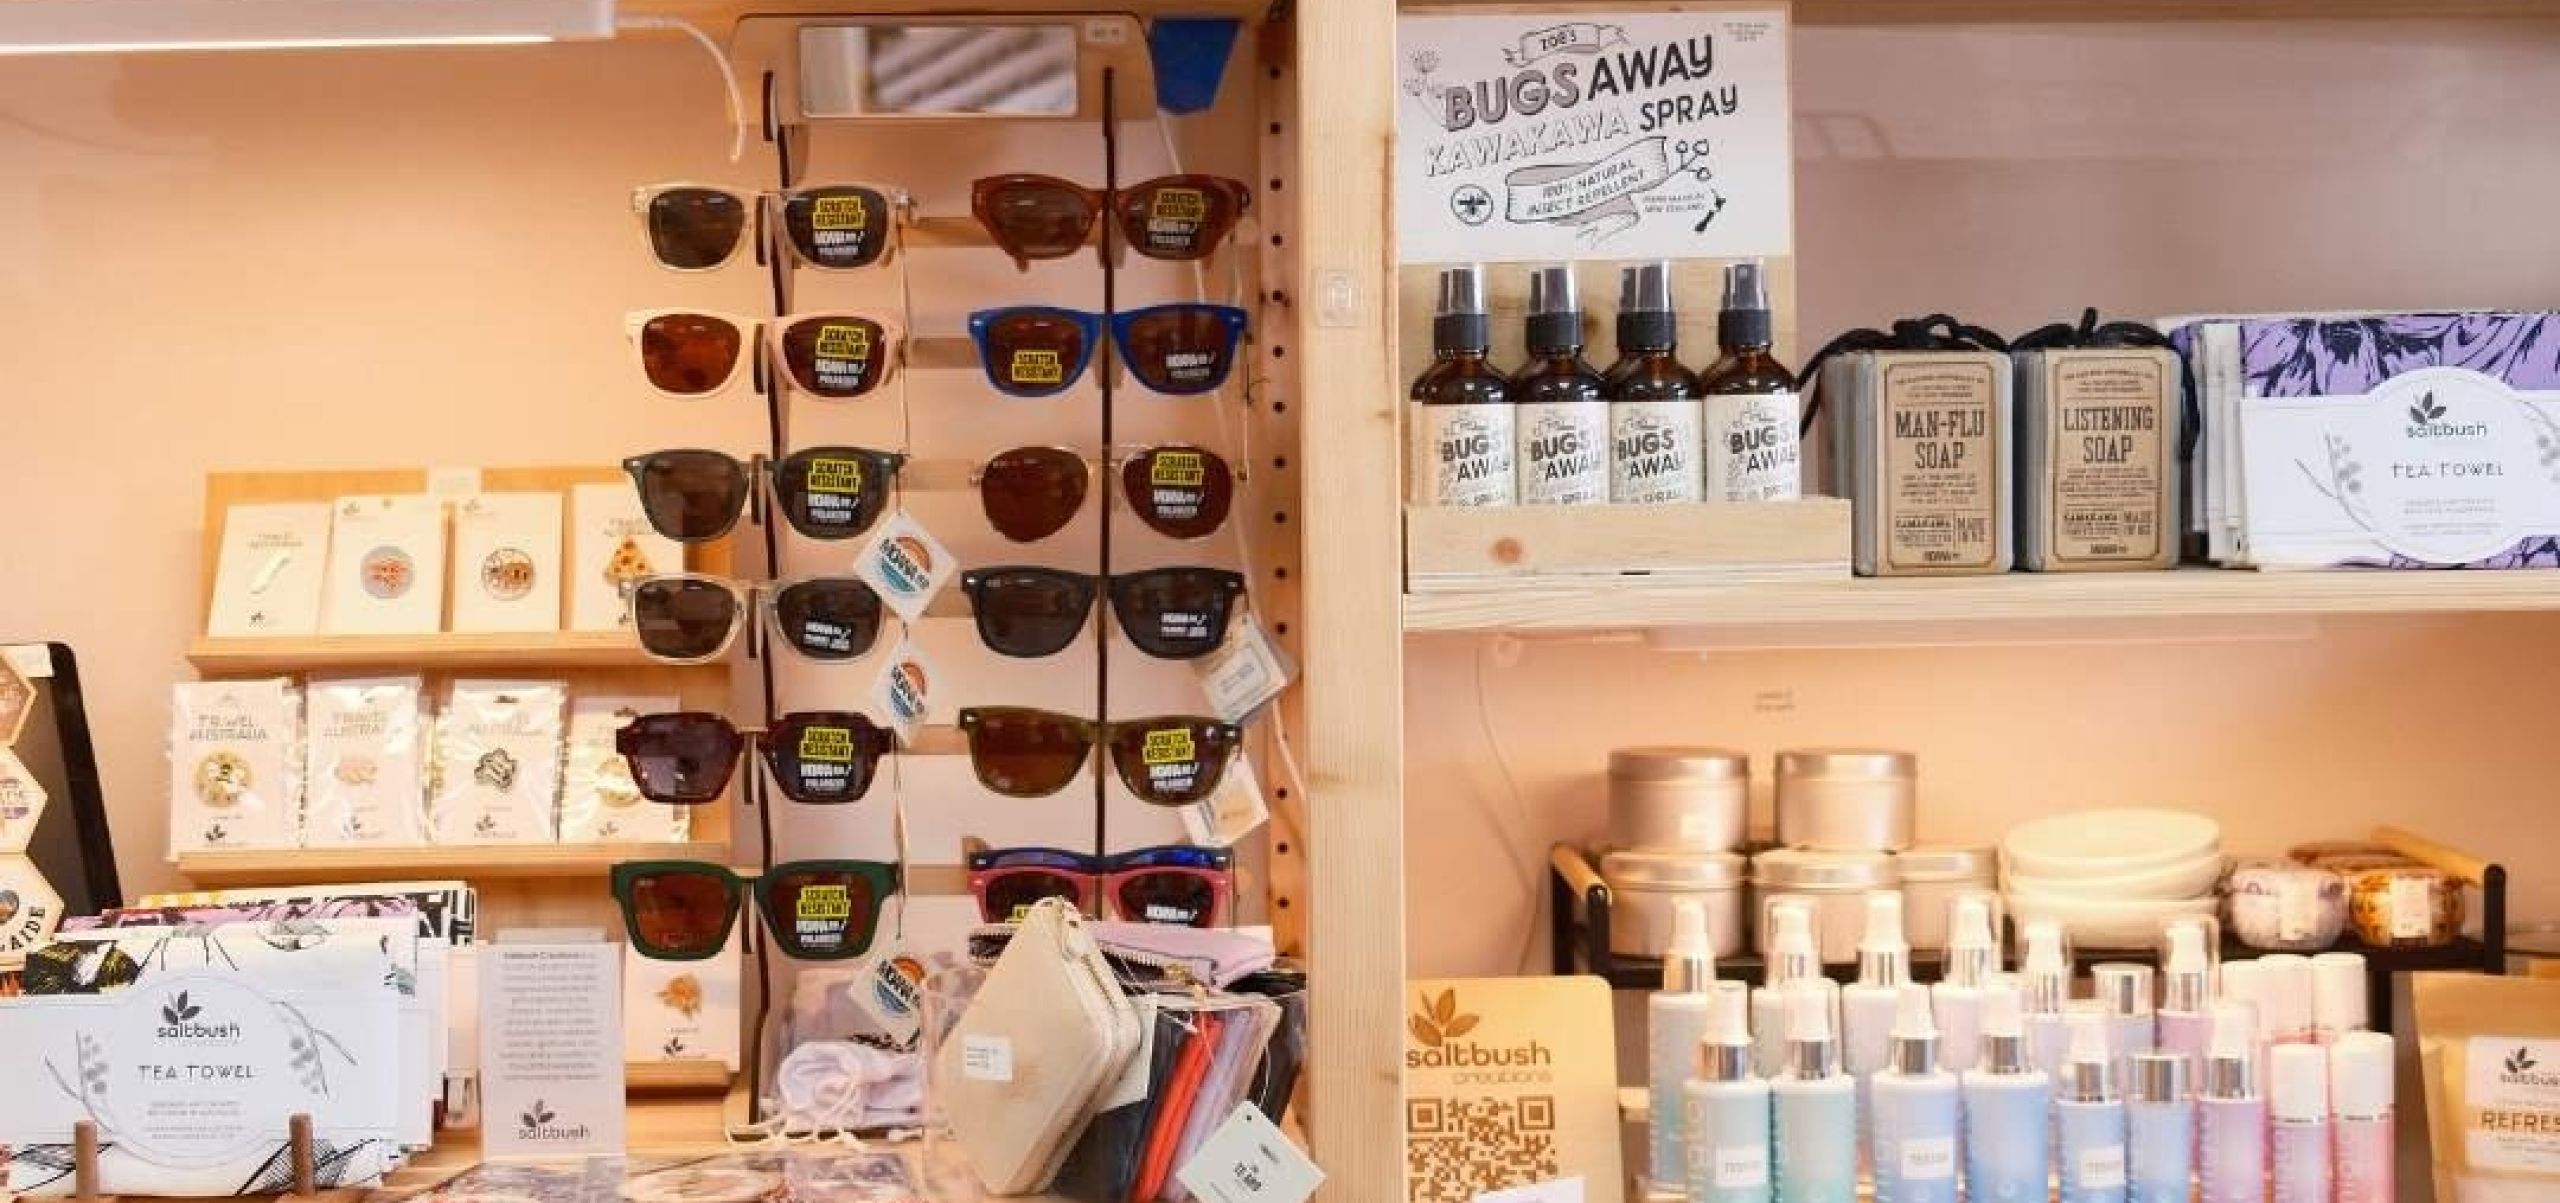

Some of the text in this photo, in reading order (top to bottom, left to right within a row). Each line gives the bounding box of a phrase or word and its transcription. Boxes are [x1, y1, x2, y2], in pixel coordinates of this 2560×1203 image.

[1444, 34, 1714, 133] BUGS AWAY
[1425, 83, 1738, 178] KAWAKAWA SPRAY
[1577, 159, 1634, 190] NATURAL
[1895, 410, 1985, 438] MAN-FLU
[2063, 406, 2153, 432] LISTENING
[2405, 422, 2487, 438] saltbush
[1530, 430, 1589, 462] BUGS
[1617, 429, 1675, 461] BUGS
[1729, 424, 1793, 455] BUGS
[2082, 436, 2132, 464] SOAP
[1545, 452, 1600, 482] AWAY
[1628, 451, 1683, 481] AWAY
[1914, 441, 1964, 469] SOAP
[2390, 461, 2504, 479] TEA TOWEL
[156, 1022, 240, 1039] saltbush
[1406, 1040, 1551, 1068] saltbush
[138, 1064, 256, 1080] TEA TOWEL
[1451, 1069, 1553, 1085] creations
